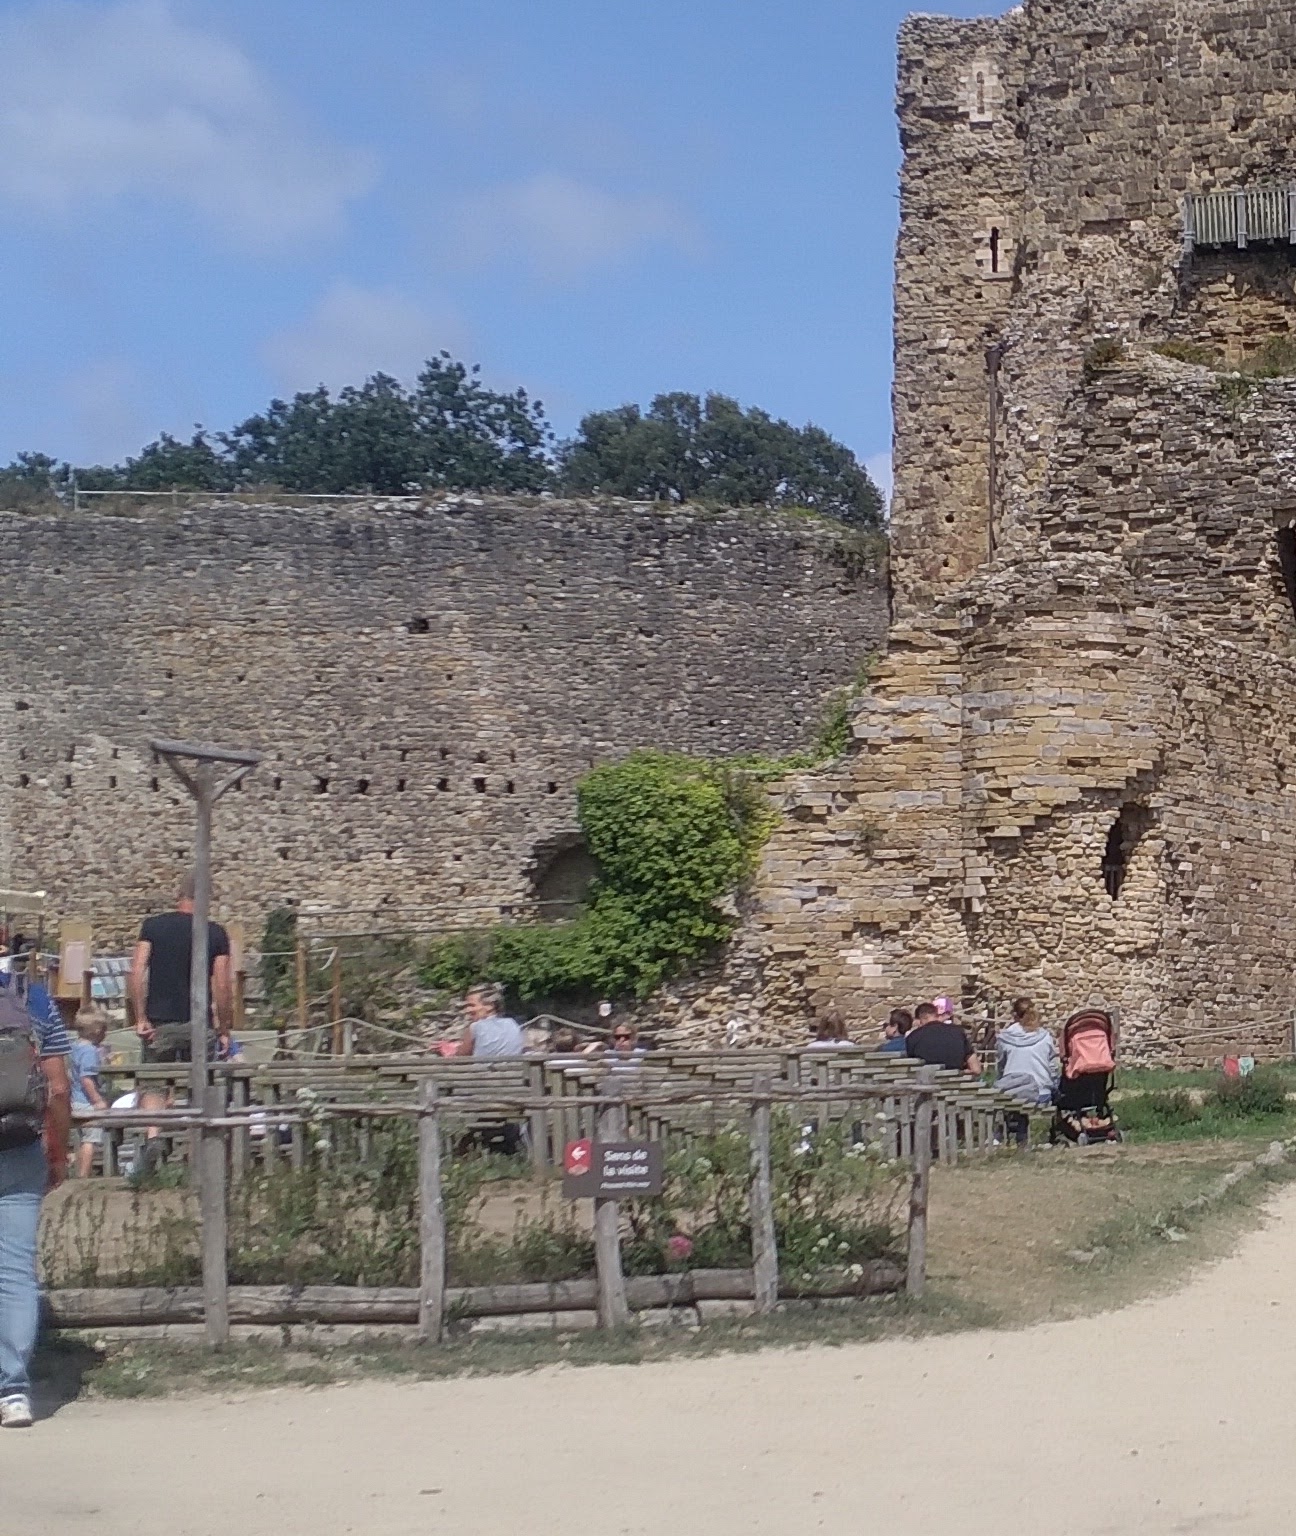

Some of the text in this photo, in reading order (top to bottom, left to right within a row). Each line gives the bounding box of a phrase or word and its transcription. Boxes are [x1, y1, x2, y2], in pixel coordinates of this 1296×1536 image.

[603, 1148, 648, 1161] Sens de
[603, 1164, 649, 1176] la visite
